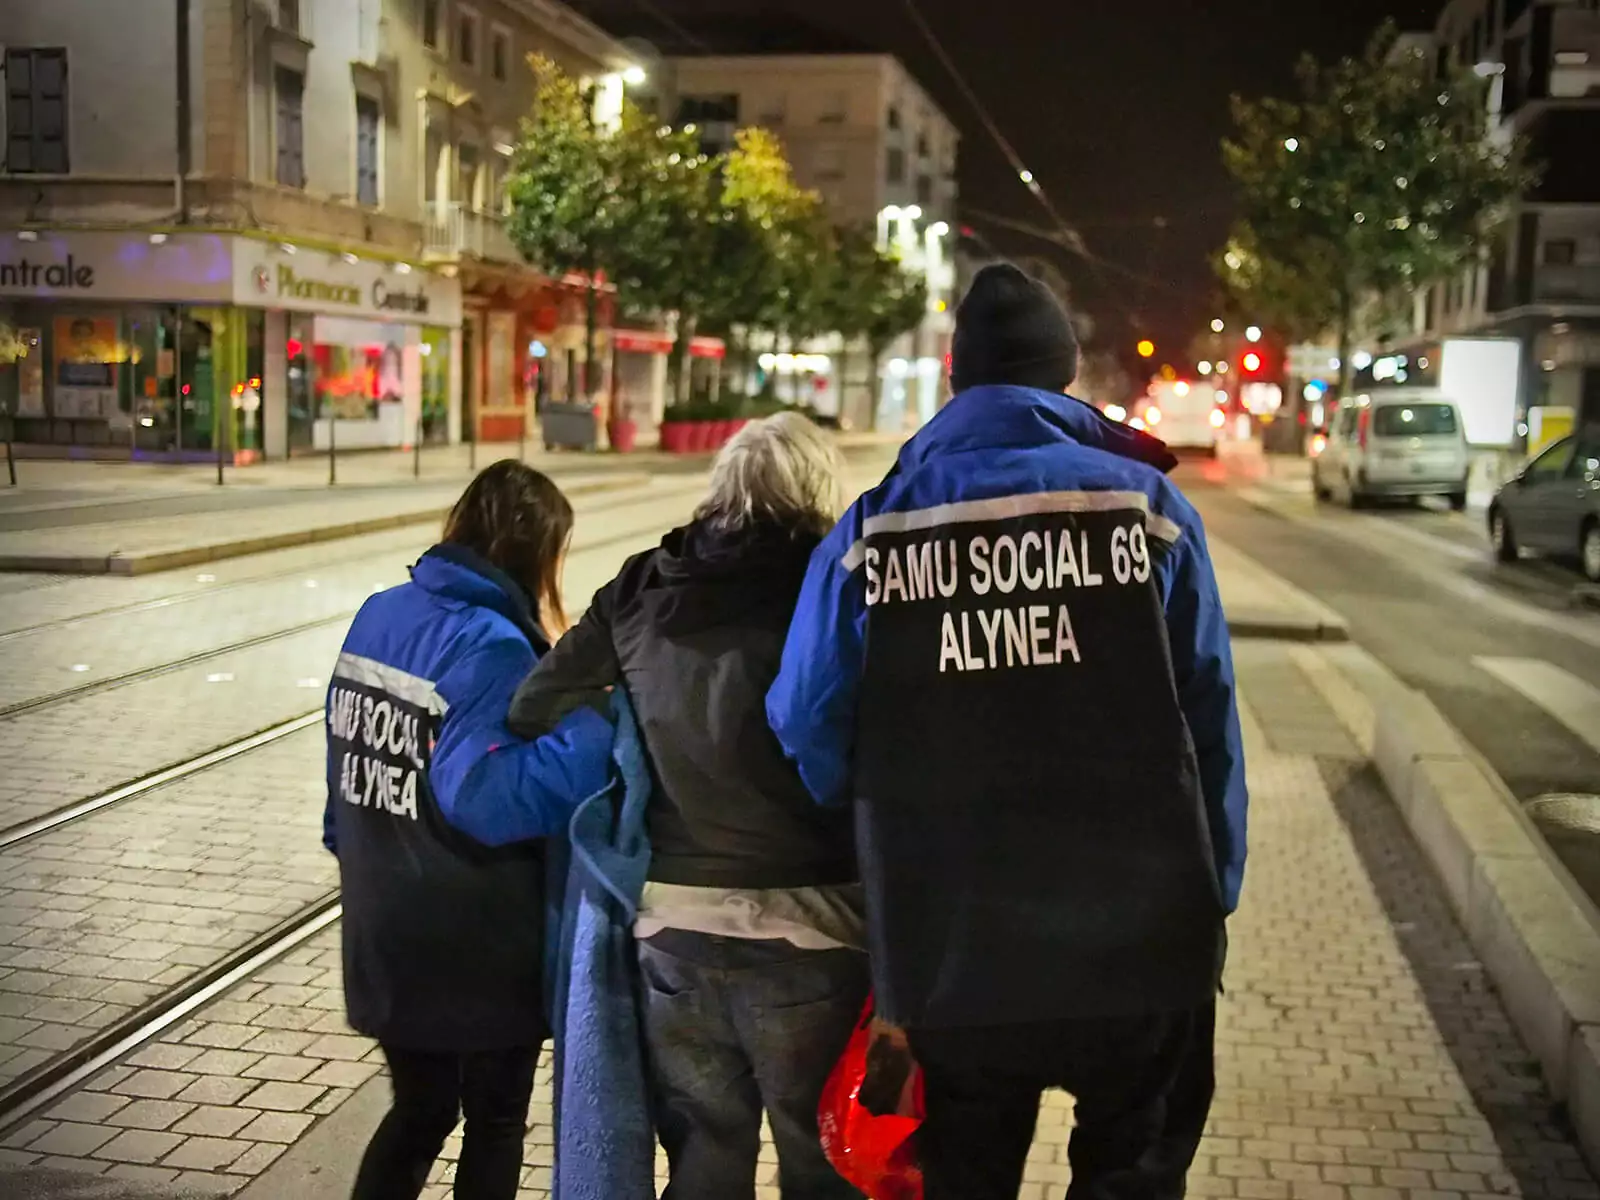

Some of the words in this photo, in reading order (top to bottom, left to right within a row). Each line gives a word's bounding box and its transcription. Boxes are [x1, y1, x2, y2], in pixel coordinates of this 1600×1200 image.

[865, 539, 958, 606] SAMU
[969, 528, 1103, 595] SOCIAL
[1110, 523, 1151, 584] 69
[939, 604, 1081, 673] ALYNEA
